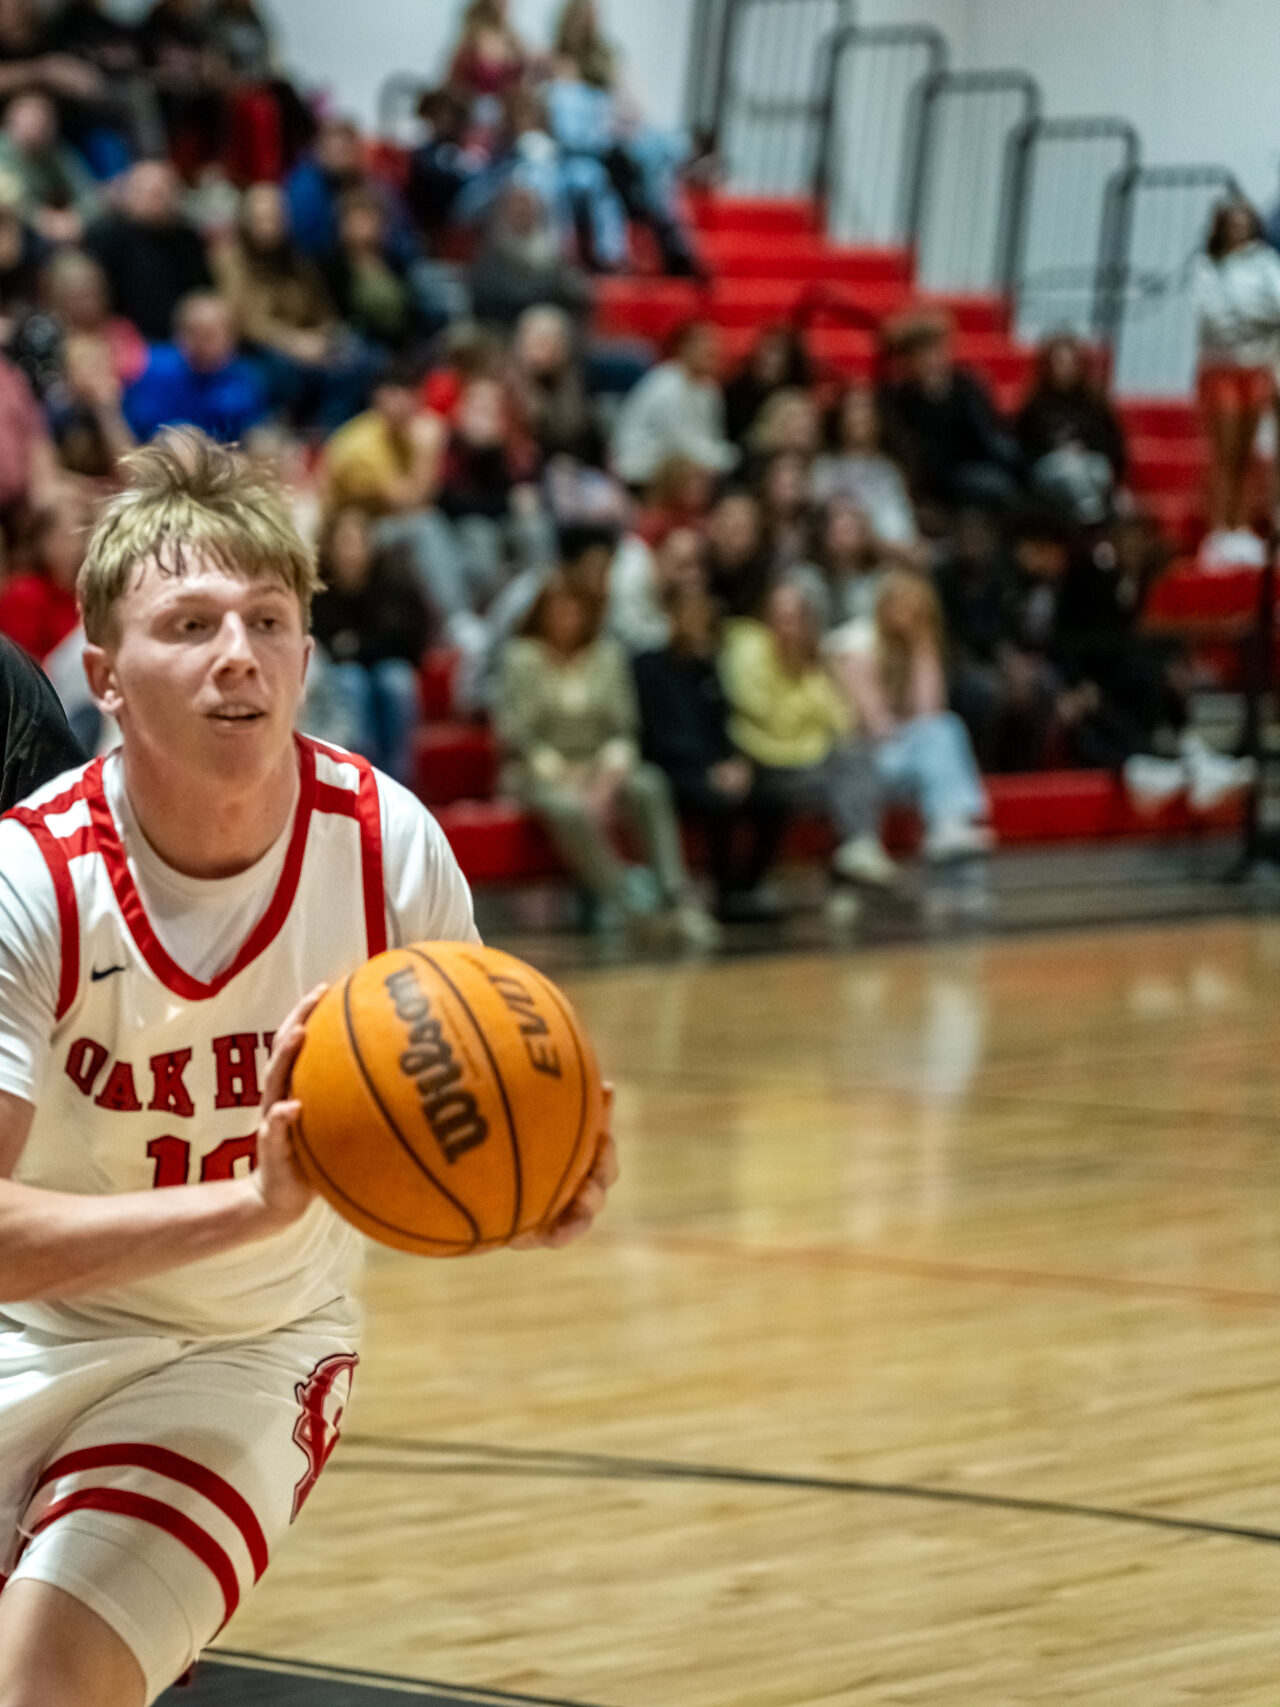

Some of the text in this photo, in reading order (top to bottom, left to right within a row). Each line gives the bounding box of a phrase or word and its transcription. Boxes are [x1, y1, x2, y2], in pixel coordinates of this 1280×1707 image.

[64, 1031, 278, 1119] OAK H
[384, 963, 490, 1166] Wilson
